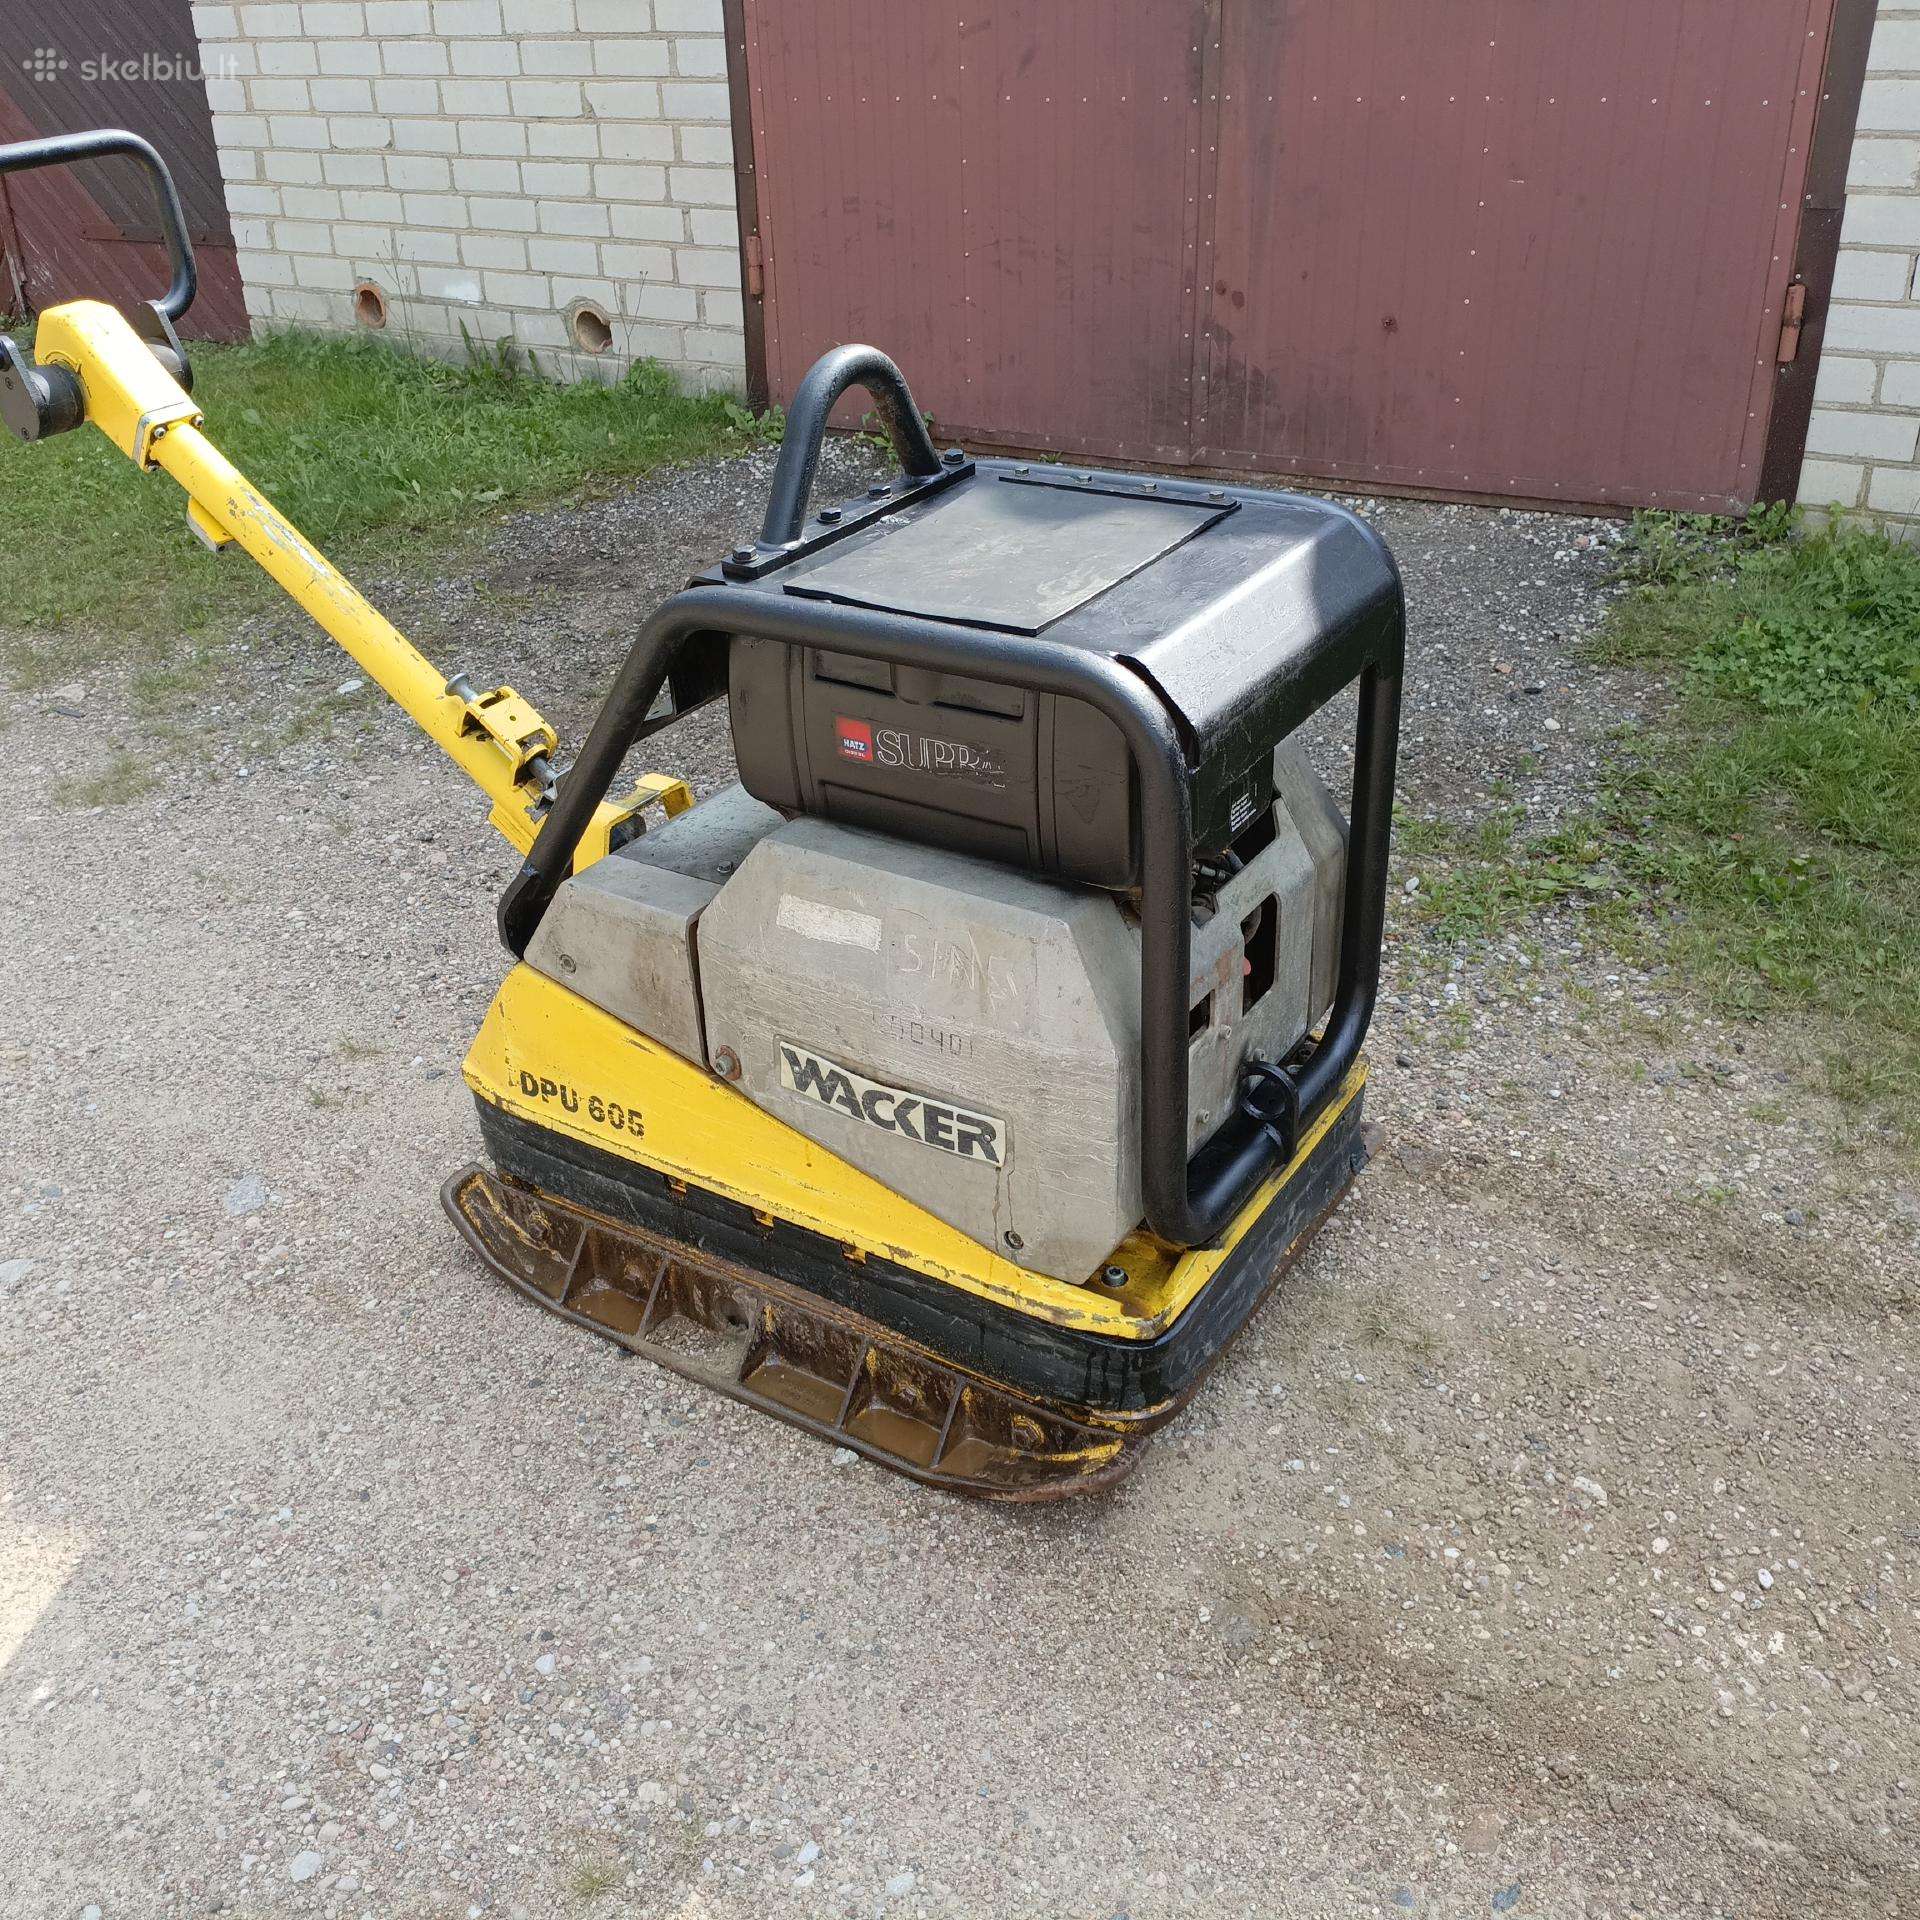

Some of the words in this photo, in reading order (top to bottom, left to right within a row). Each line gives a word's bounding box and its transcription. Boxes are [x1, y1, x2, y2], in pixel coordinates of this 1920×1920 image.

[843, 738, 866, 752] HATZ
[876, 728, 1006, 788] SUPR
[519, 1069, 579, 1114] DPU
[588, 1095, 645, 1138] 605
[780, 1046, 1000, 1164] WACKER
